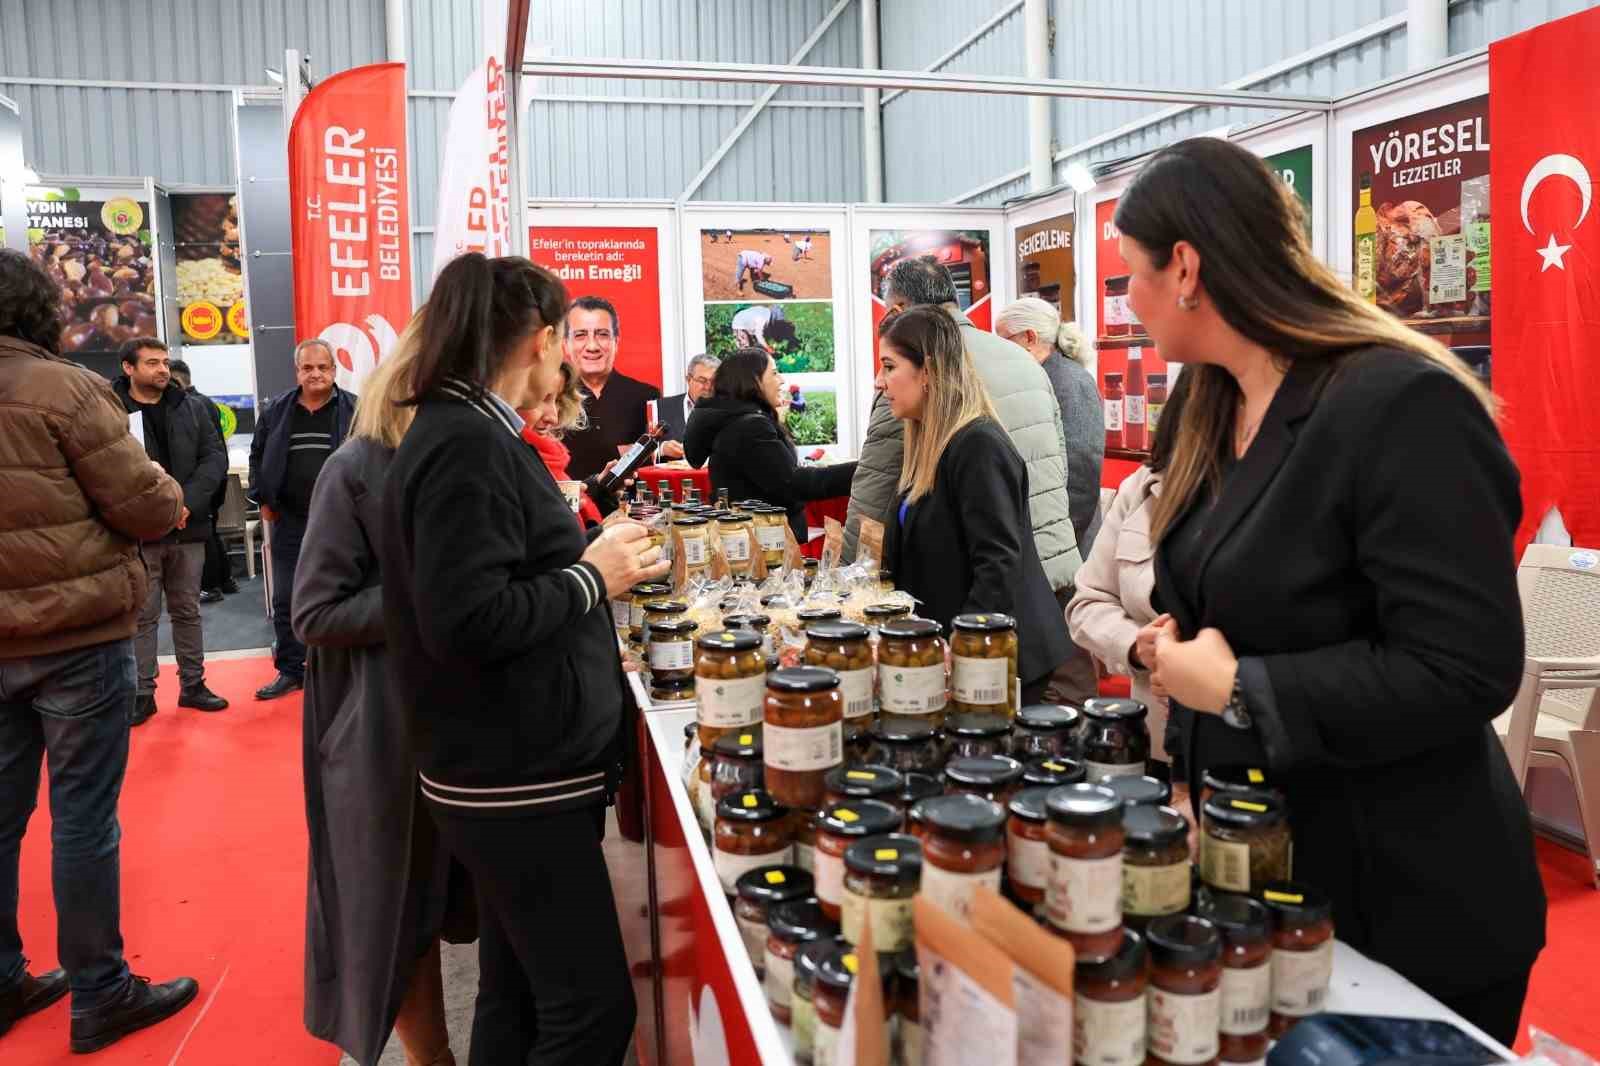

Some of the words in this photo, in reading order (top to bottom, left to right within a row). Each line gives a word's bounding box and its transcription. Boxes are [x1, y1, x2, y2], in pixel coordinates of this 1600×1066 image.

[1369, 116, 1490, 175] YÖRESEL
[1392, 158, 1462, 188] LEZZETLER
[307, 194, 321, 220] T.C.
[325, 126, 370, 296] EFELER
[370, 147, 400, 281] BELEDİYESİ
[554, 250, 604, 261] bereketin
[606, 250, 625, 261] adı:
[577, 239, 645, 251] topraklarında
[1018, 229, 1071, 262] ŞEKERLEME
[588, 264, 642, 282] Emeği!
